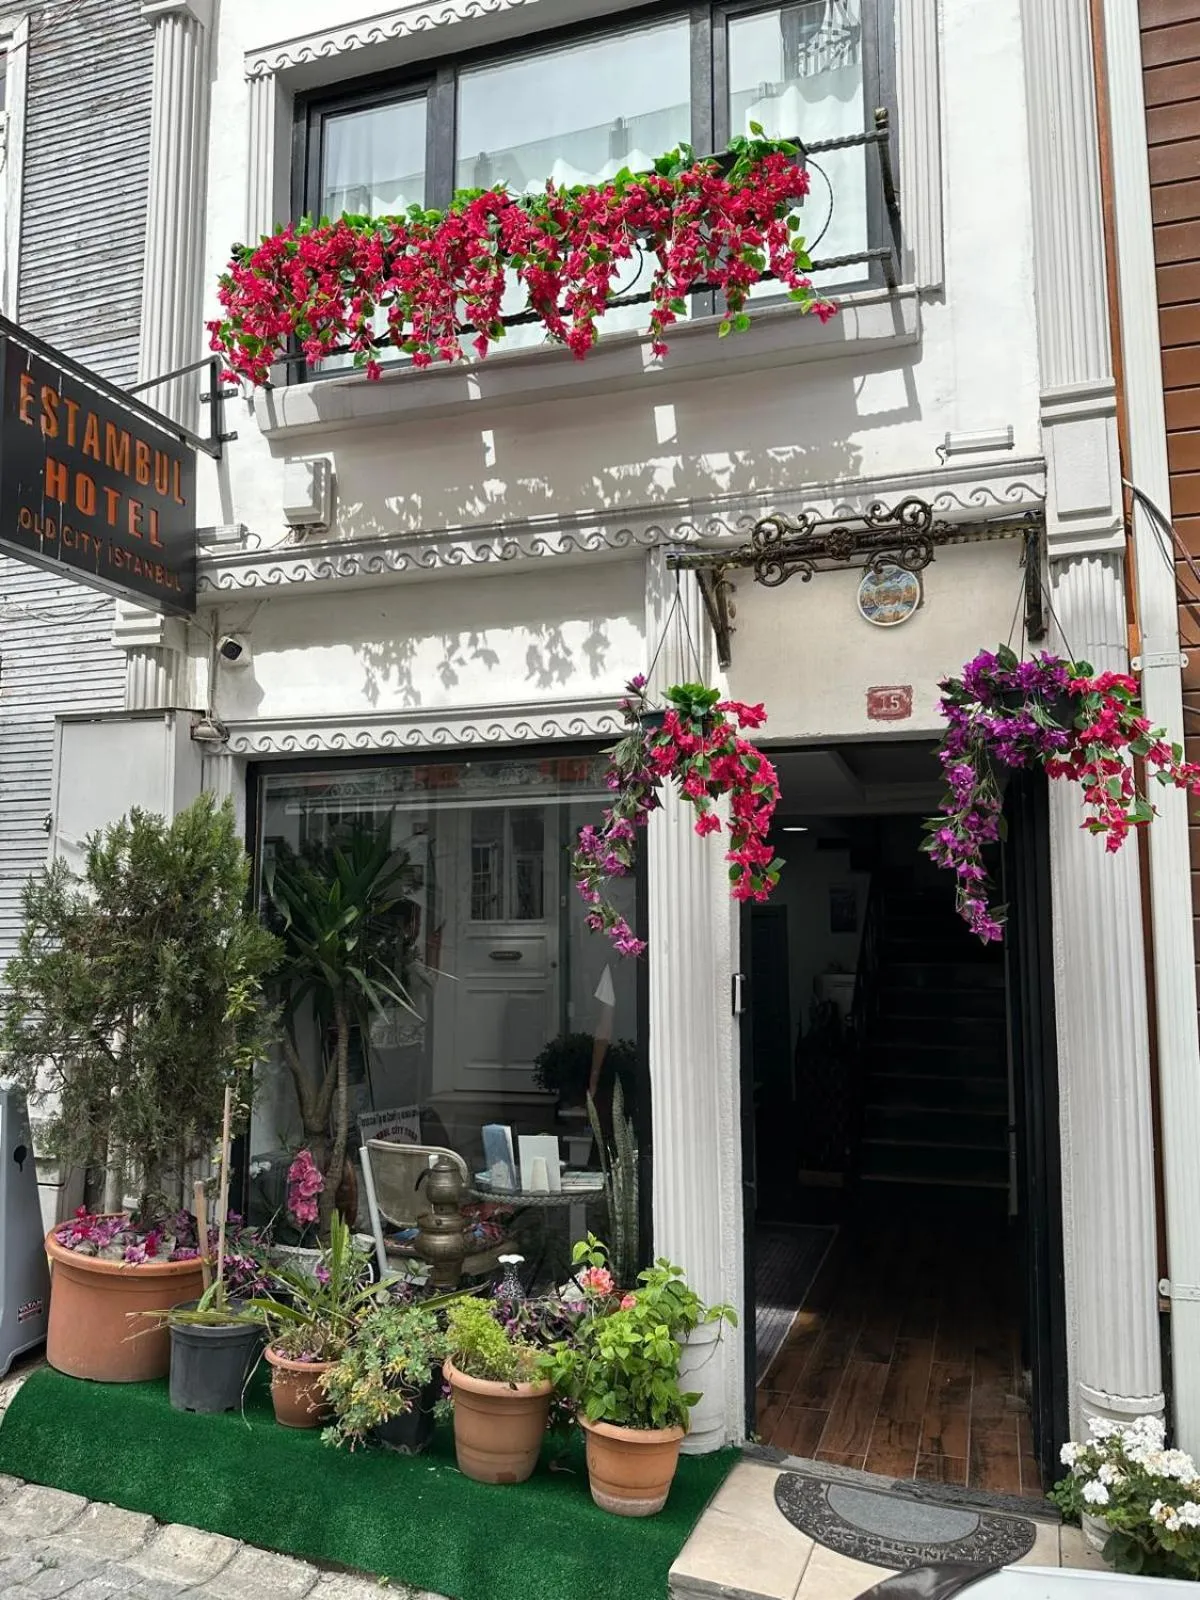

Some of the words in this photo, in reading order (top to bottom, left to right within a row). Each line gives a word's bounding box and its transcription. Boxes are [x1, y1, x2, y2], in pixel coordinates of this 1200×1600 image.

[19, 372, 186, 505] ESTAMBUL
[19, 506, 56, 539] OLD
[62, 525, 103, 555] CITY
[45, 456, 164, 547] HOTEL
[880, 695, 900, 712] 15
